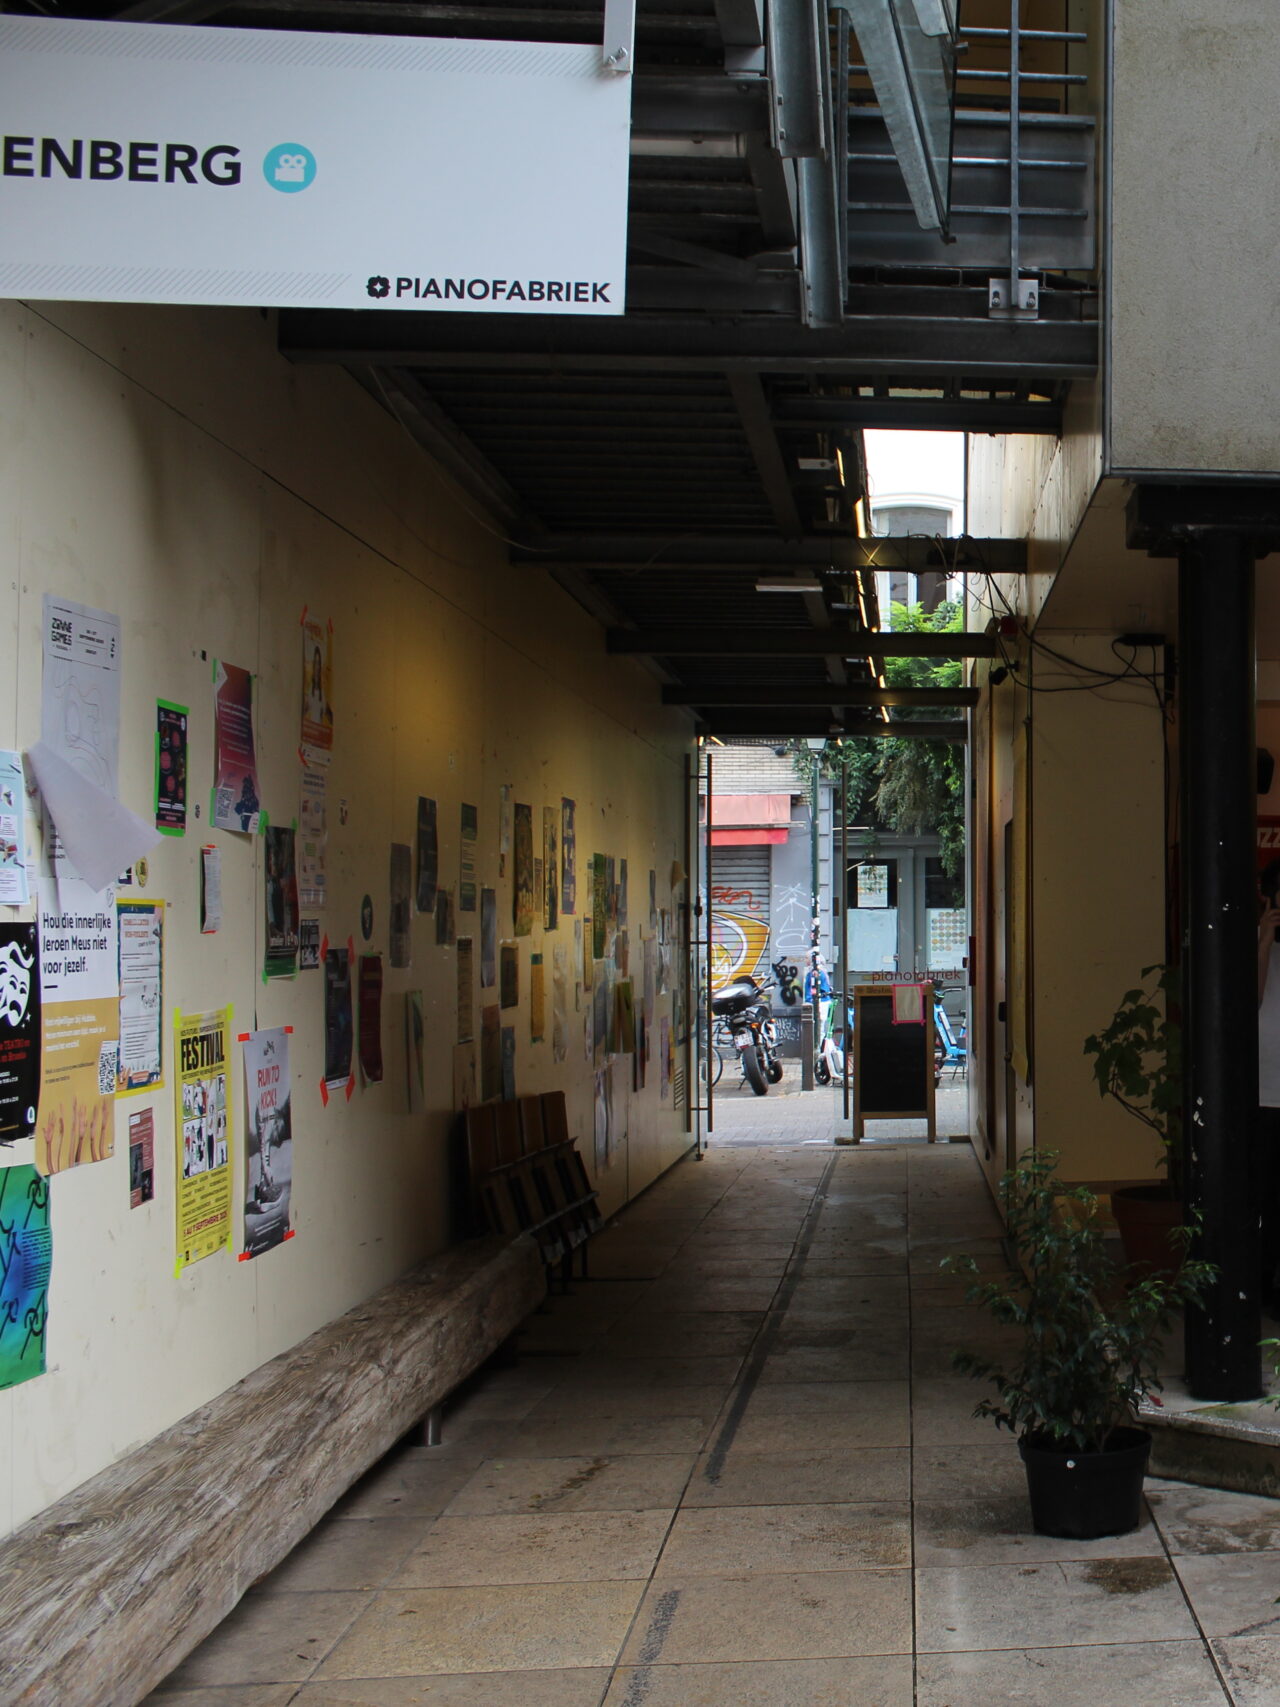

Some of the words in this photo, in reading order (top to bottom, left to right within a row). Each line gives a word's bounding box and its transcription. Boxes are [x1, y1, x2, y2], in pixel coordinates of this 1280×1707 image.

[3, 136, 242, 186] ENBERG
[395, 276, 611, 303] PIANOFABRIEK
[43, 913, 60, 929] Hou
[61, 913, 74, 928] die
[75, 912, 112, 932] innerlijke
[43, 935, 70, 952] Jeroen
[71, 935, 91, 951] Meus
[93, 936, 107, 950] niet
[43, 961, 62, 974] voor
[64, 956, 88, 976] jezelf.
[872, 966, 961, 985] pianofabriek
[180, 1031, 225, 1073] FESTIVAL
[258, 1068, 271, 1088] RUN
[260, 1088, 277, 1109] KICK!
[195, 1214, 219, 1231] SEPTEMBRE
